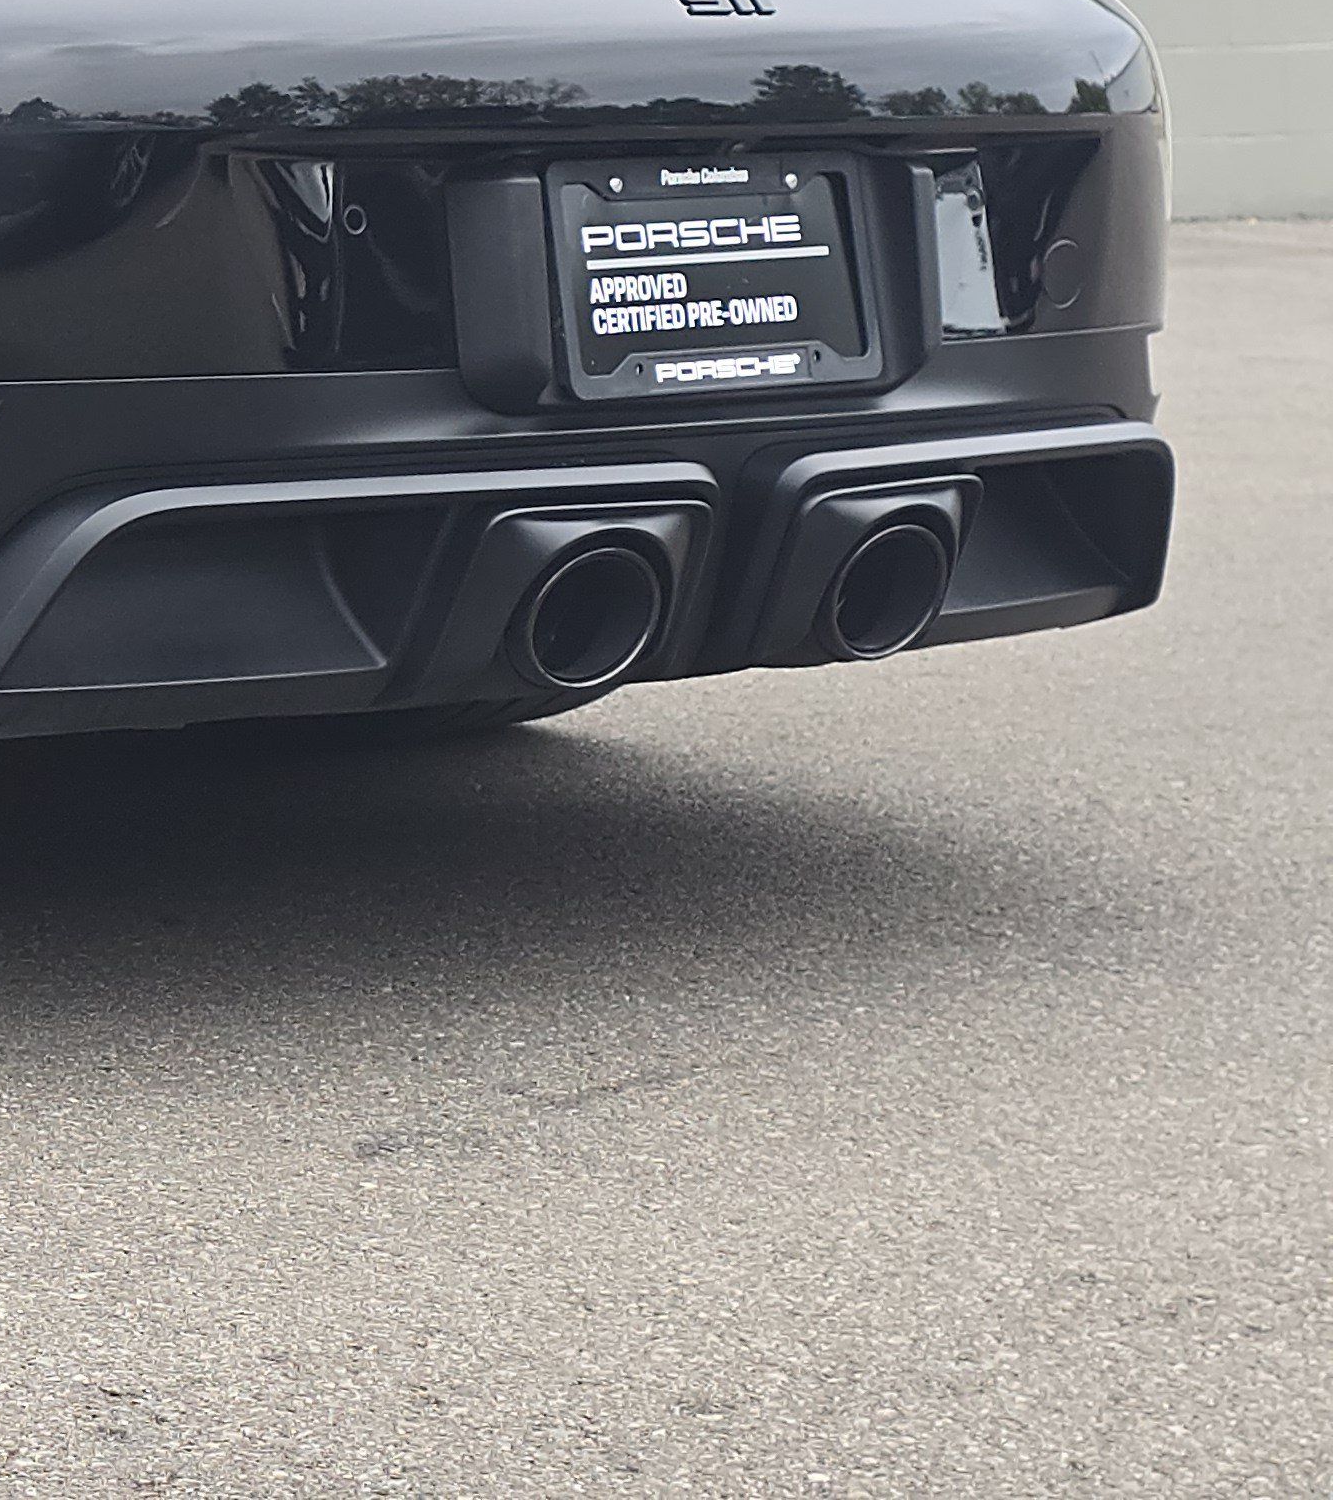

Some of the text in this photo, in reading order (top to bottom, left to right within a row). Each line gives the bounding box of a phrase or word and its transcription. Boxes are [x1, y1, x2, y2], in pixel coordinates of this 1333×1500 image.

[581, 214, 802, 253] PORSCHE
[590, 272, 688, 304] APPROVED
[592, 295, 798, 335] CERTIFIED PRE-OWNED
[655, 353, 798, 383] PORSCHE
